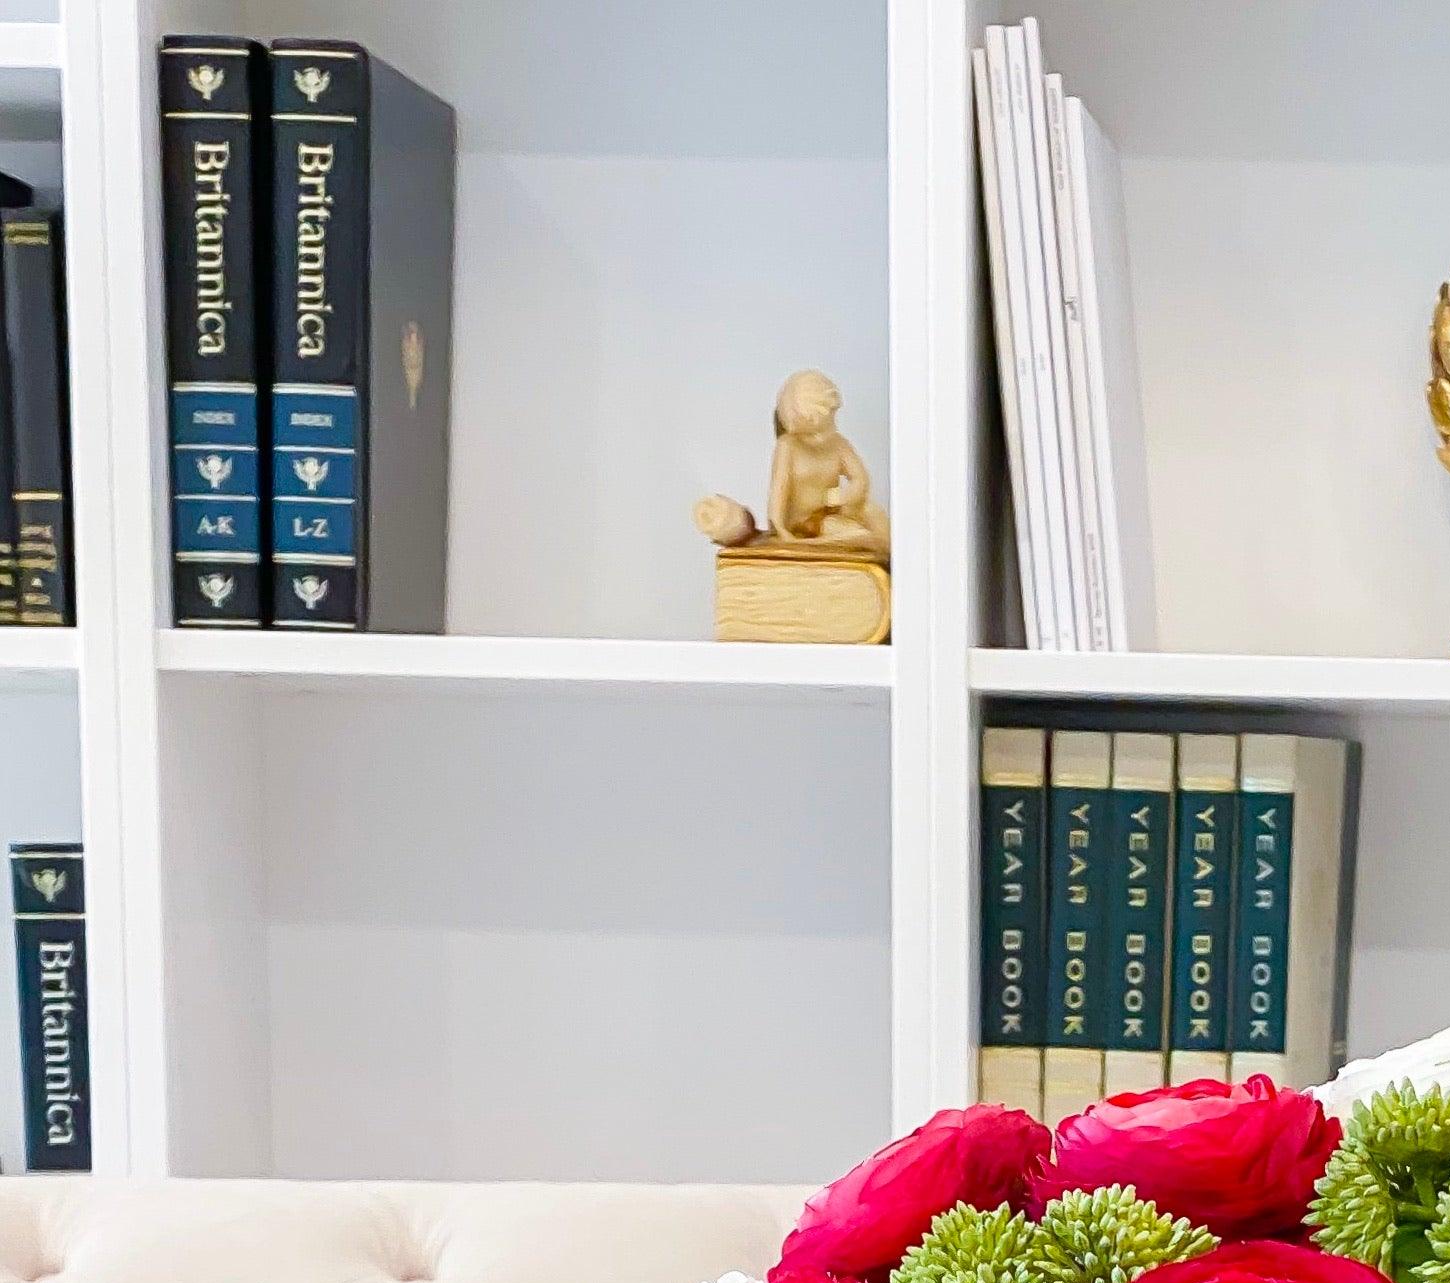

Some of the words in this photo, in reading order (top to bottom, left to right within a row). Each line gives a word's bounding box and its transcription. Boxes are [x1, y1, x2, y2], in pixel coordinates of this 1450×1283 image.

[194, 142, 232, 356] Britannica
[298, 144, 335, 357] Britannica
[1001, 929, 1023, 1035] BOOK
[1063, 930, 1087, 1035] BOOK
[1123, 933, 1147, 1039] BOOK
[1189, 934, 1213, 1039] BOOK
[1250, 935, 1273, 1040] BOOK
[39, 941, 81, 1145] Britannica
